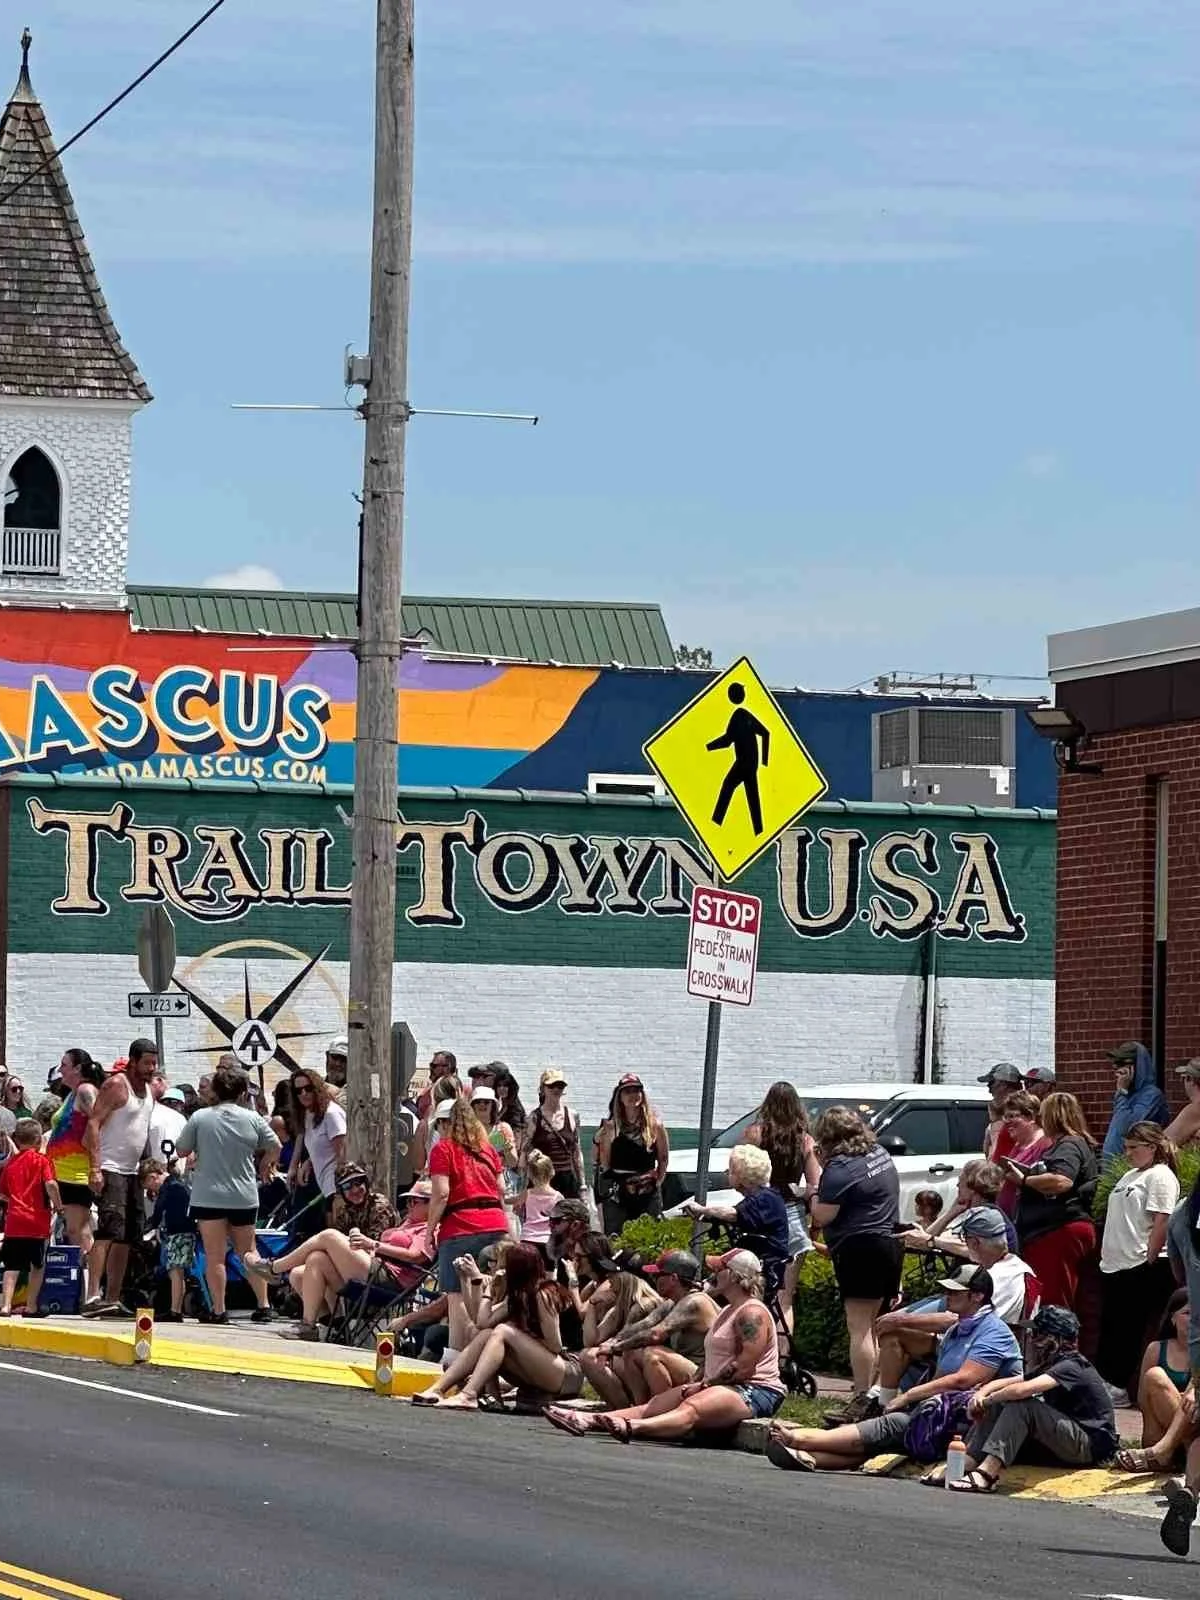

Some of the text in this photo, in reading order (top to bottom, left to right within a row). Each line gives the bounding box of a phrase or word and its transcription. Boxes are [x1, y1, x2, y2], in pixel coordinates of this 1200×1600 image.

[26, 798, 353, 924] TRAIL
[397, 810, 718, 928] TOWN
[696, 894, 756, 929] STOP
[717, 930, 732, 941] FOR
[694, 938, 752, 964] PEDESTRIAN
[717, 961, 725, 972] IN
[691, 970, 749, 994] CROSSWALK
[150, 998, 171, 1011] 1223
